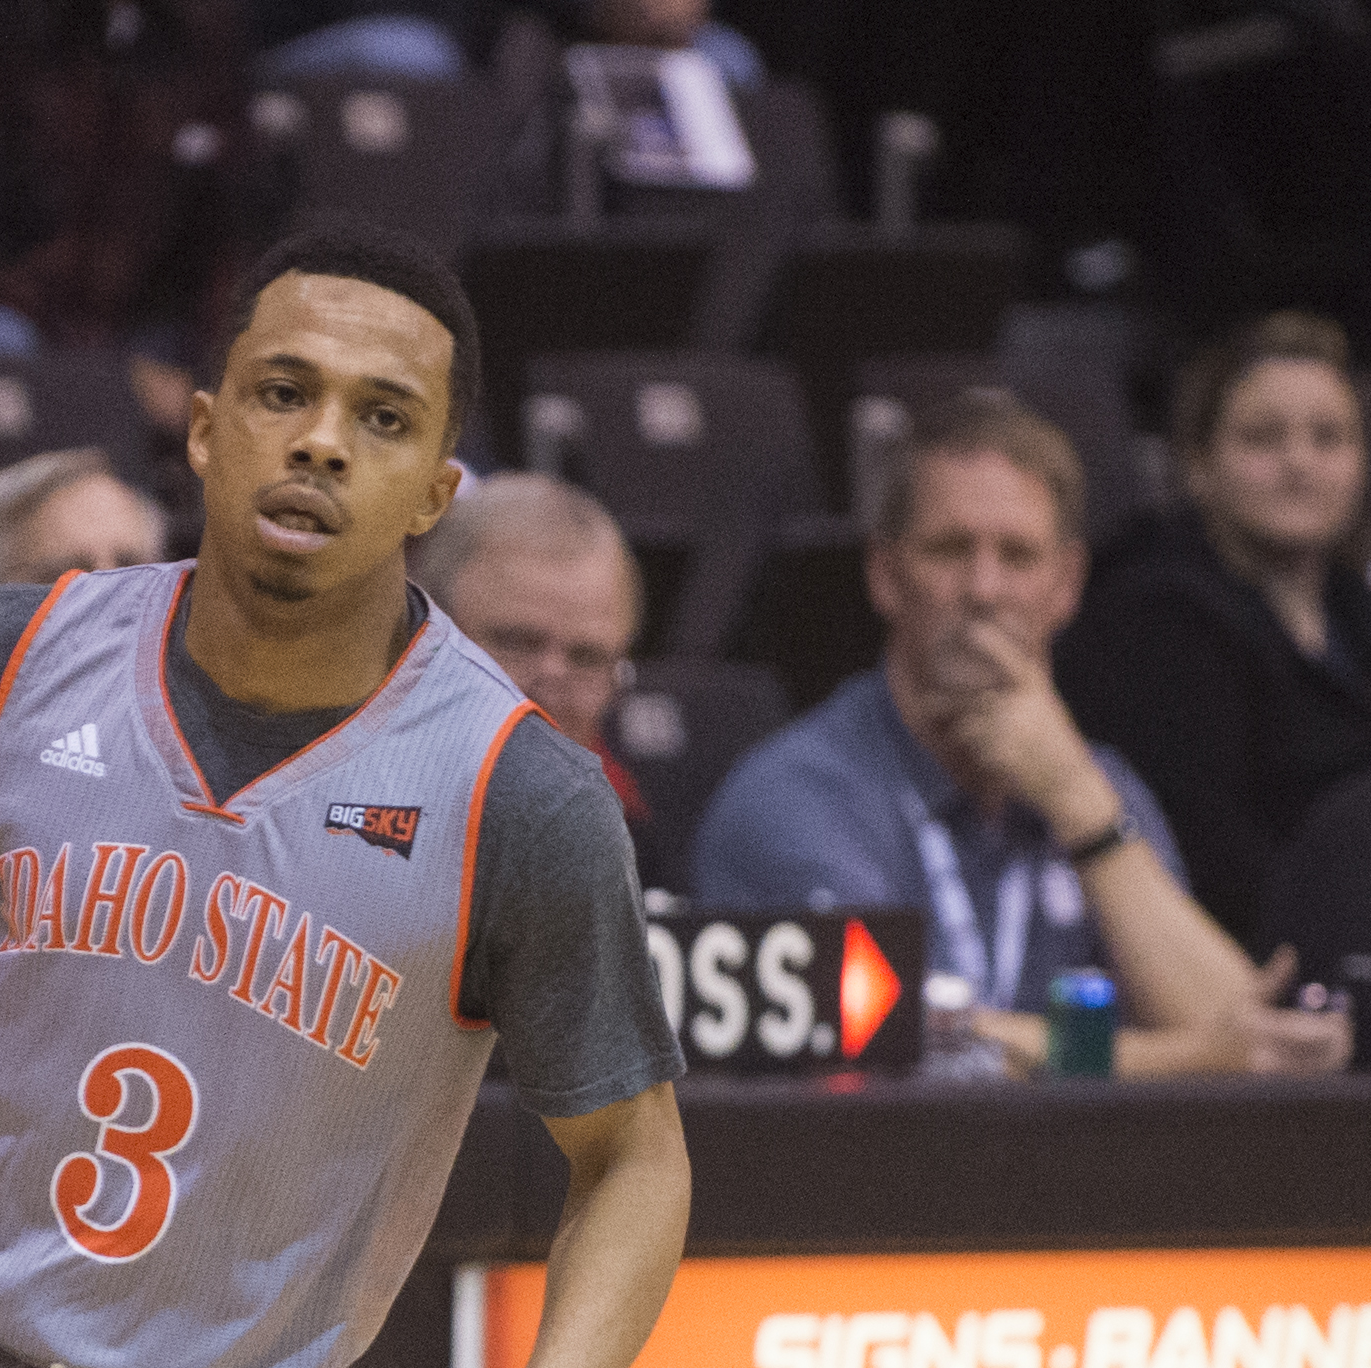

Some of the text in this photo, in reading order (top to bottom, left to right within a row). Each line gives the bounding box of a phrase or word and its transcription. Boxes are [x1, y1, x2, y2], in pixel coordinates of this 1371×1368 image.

[39, 748, 107, 778] adidas
[189, 871, 403, 1072] STATE
[50, 1042, 198, 1264] 3
